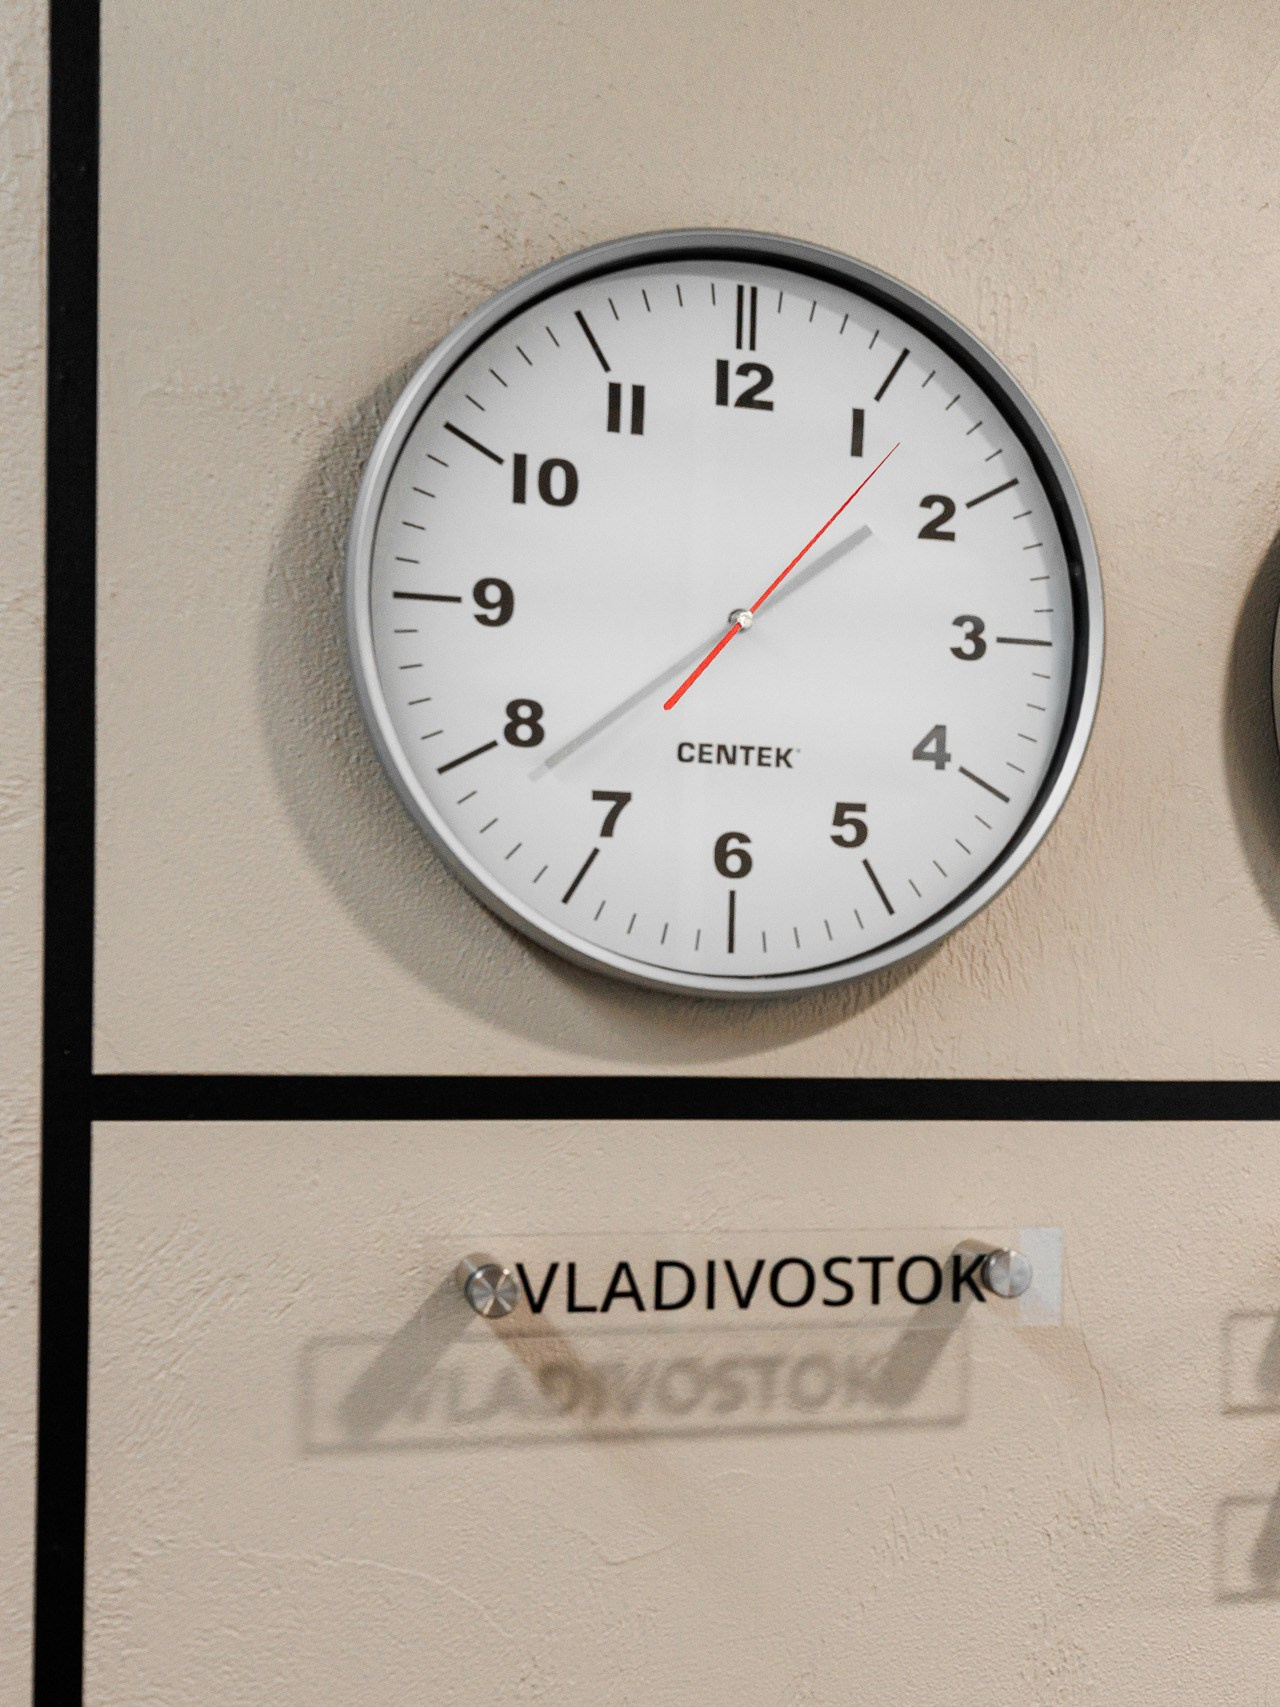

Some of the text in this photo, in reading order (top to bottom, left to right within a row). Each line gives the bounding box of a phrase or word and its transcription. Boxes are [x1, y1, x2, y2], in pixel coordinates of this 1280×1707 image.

[715, 358, 774, 412] 12
[512, 452, 579, 507] 10
[917, 494, 956, 542] 2
[472, 577, 515, 628] 9
[950, 614, 987, 662] 3
[503, 698, 545, 748] 8
[677, 742, 793, 769] CENTEK
[911, 724, 952, 771] 4
[591, 790, 632, 838] 7
[830, 801, 868, 849] 5
[713, 831, 753, 879] 6
[516, 1254, 989, 1315] VLADIVOSTOK
